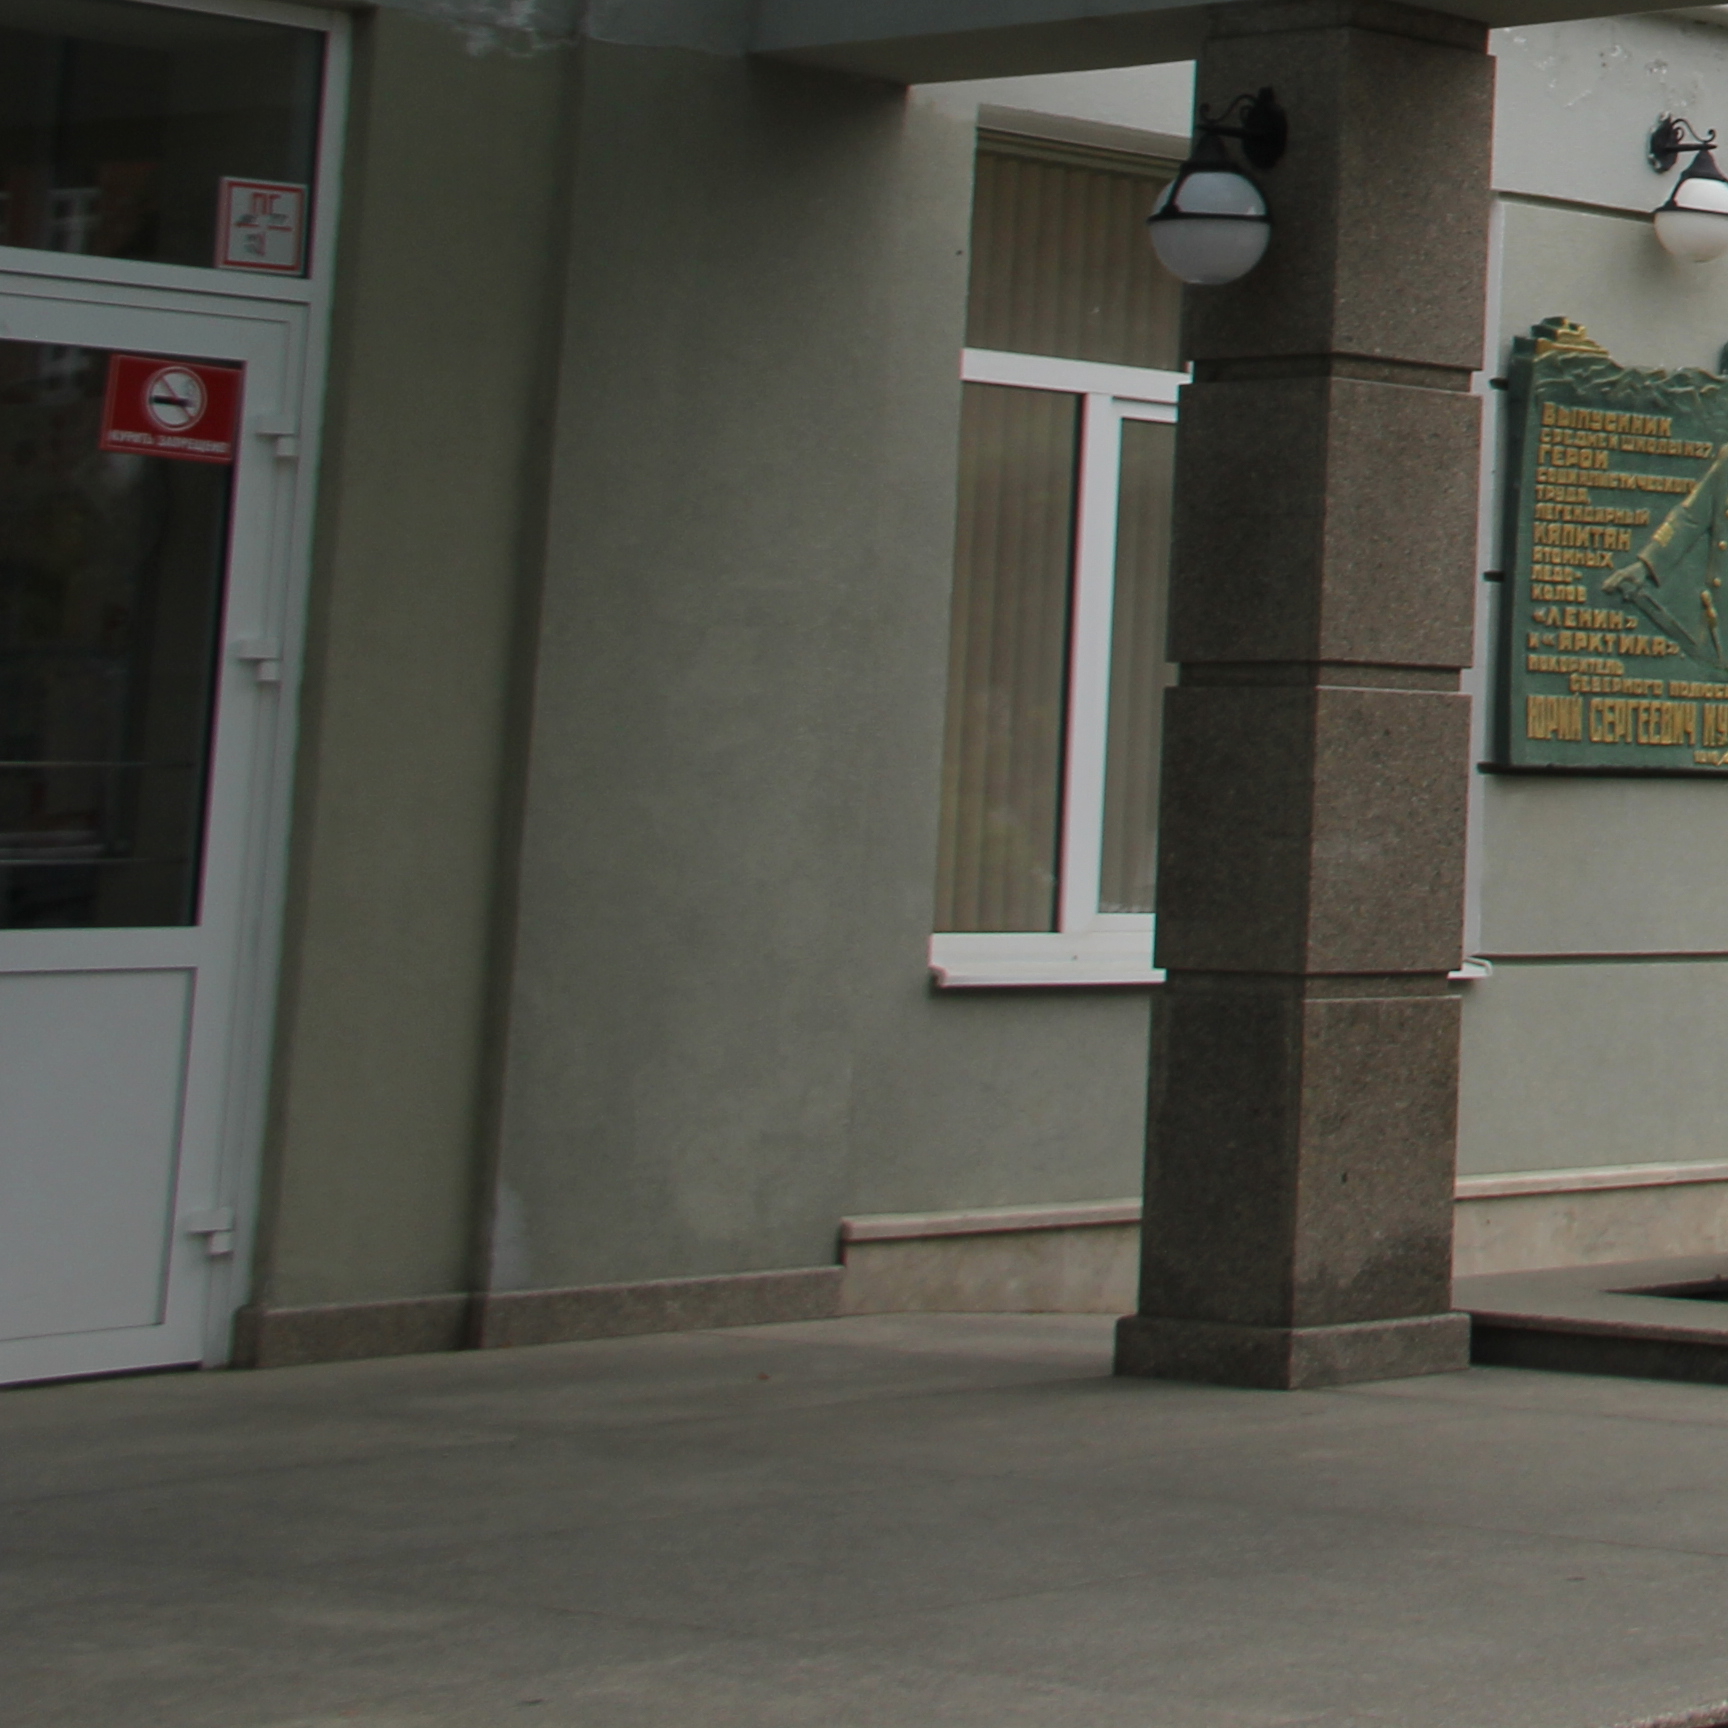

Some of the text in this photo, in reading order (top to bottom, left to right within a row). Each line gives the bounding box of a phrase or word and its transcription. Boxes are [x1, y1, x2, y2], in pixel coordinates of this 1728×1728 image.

[1542, 402, 1673, 435] ВЫПУСКНИК
[1621, 435, 1682, 452] ШКОЛЫ
[1535, 504, 1649, 523] ЛЕГЕНДАРНЫЙ
[1534, 522, 1632, 549] КАПИТАН
[1533, 546, 1614, 566] АТОМНЫХ
[1531, 565, 1582, 580] ЛЕДО-
[1532, 584, 1587, 600] КОЛОВ
[1533, 606, 1639, 628] «ЛЕНИН»
[1528, 655, 1624, 674] ПОКОРИТЕЛЬ
[1570, 673, 1663, 693] СЕВЕРНОГО
[1527, 692, 1582, 739] ЮРИЙ
[1590, 698, 1696, 744] СЕРГЕЕВИЧ
